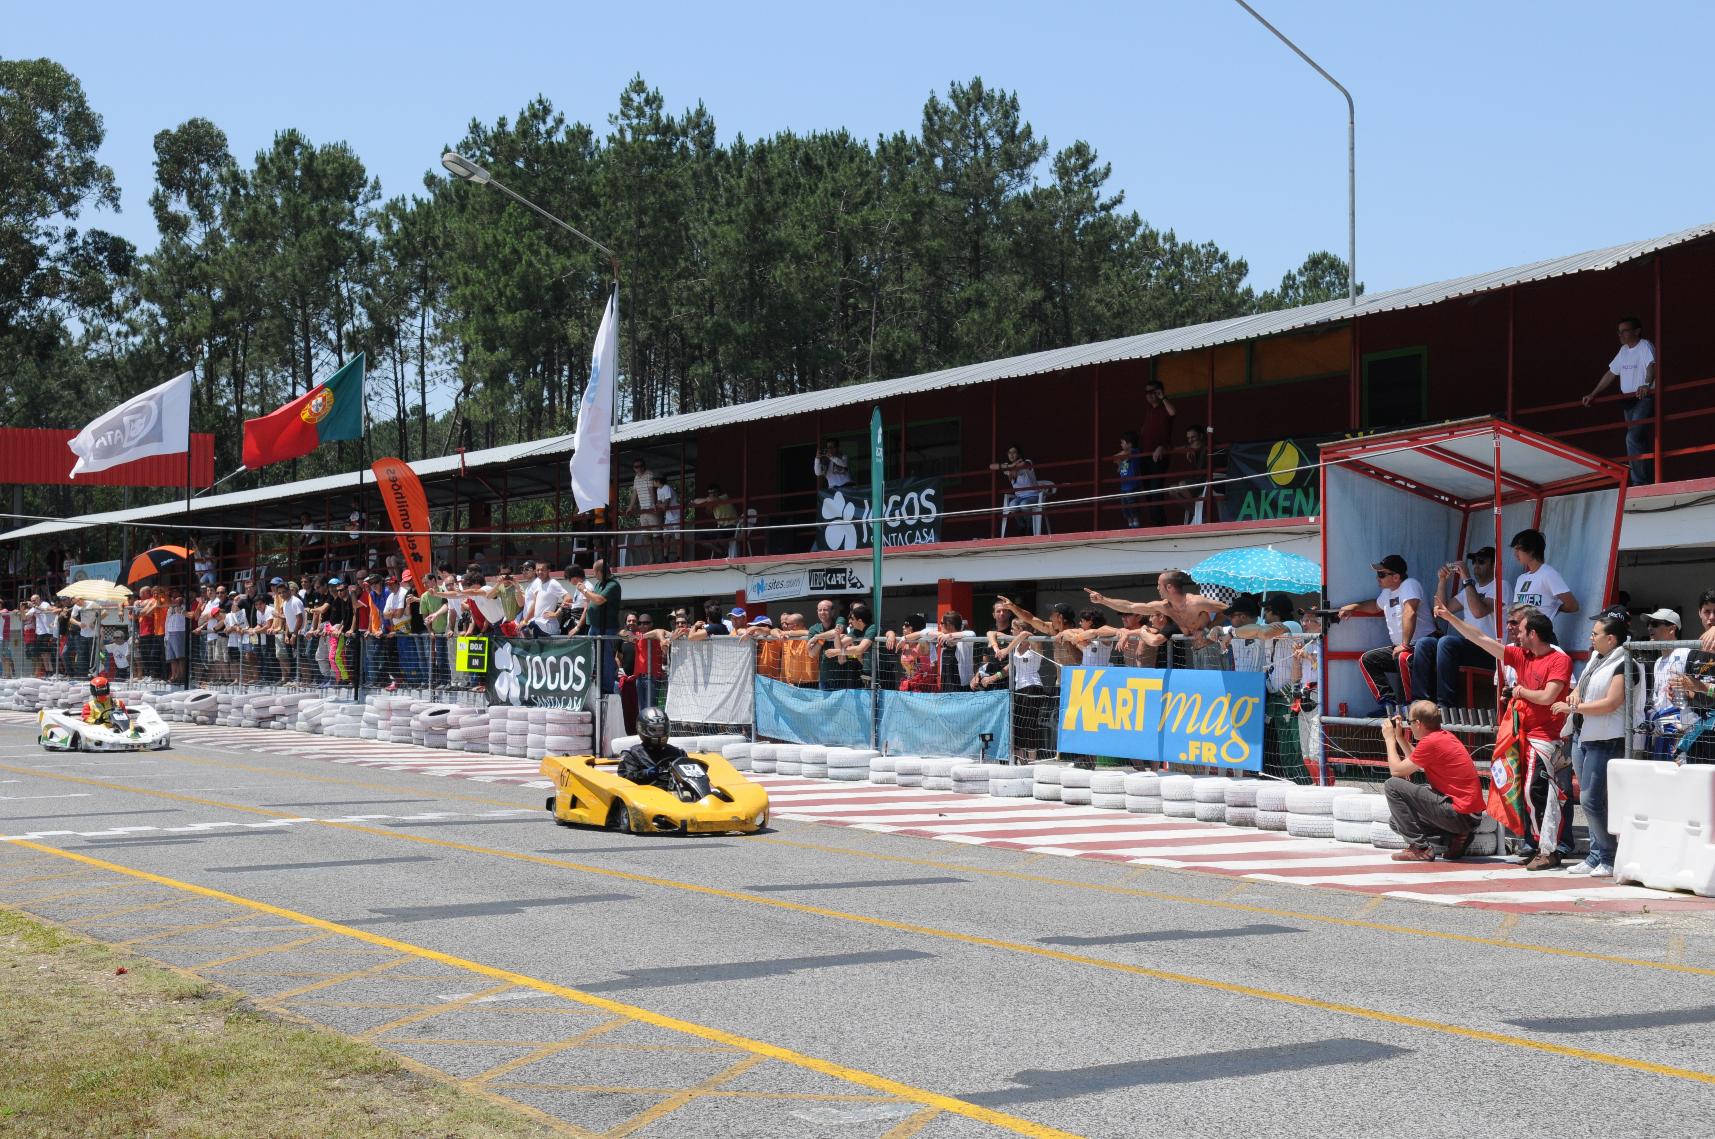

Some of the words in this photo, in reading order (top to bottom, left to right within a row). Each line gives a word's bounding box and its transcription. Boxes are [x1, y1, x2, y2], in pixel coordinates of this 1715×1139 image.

[862, 488, 937, 544] JGOS
[870, 527, 935, 547] NTACASA
[469, 642, 483, 651] BOX
[471, 658, 480, 666] IN
[523, 655, 586, 701] JOGOS
[1158, 692, 1259, 763] mag
[1179, 740, 1218, 763] .FR
